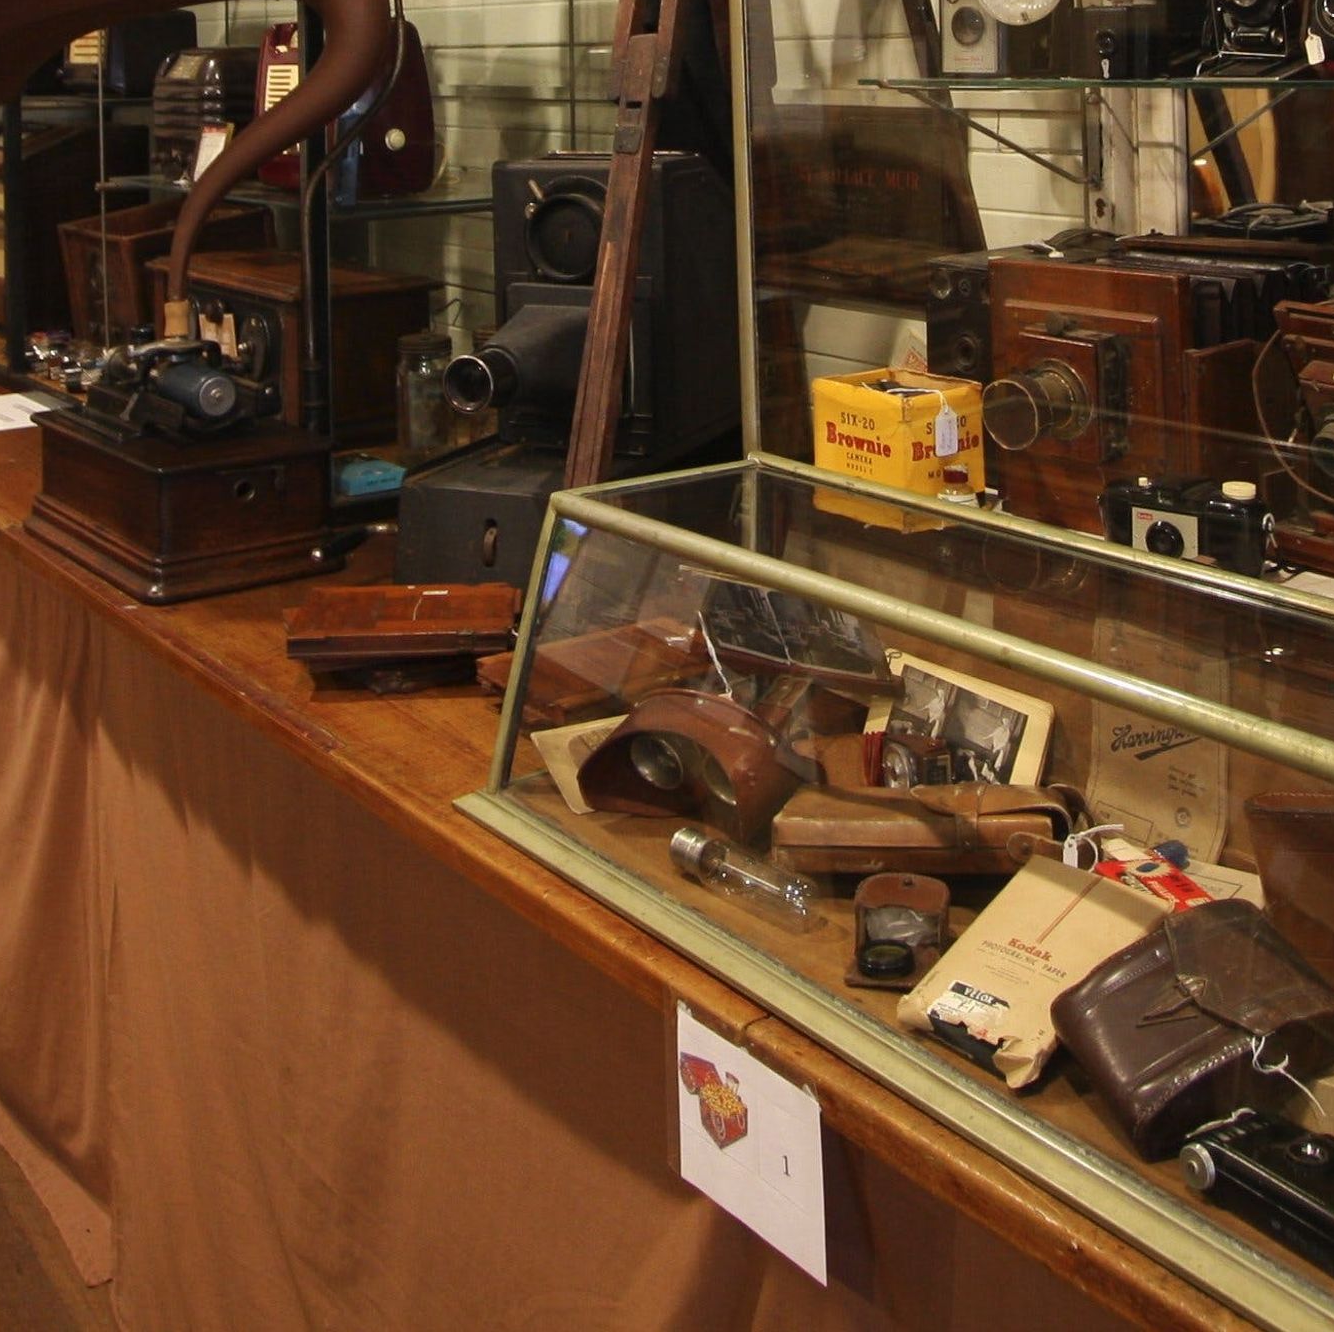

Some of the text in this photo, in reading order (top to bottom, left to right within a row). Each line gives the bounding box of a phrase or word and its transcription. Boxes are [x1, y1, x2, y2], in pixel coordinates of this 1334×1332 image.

[840, 411, 875, 431] SIX-20
[826, 421, 892, 458] Brownie
[912, 431, 980, 462] Brnie
[1007, 937, 1053, 962] Kodak
[781, 1154, 791, 1177] 1
